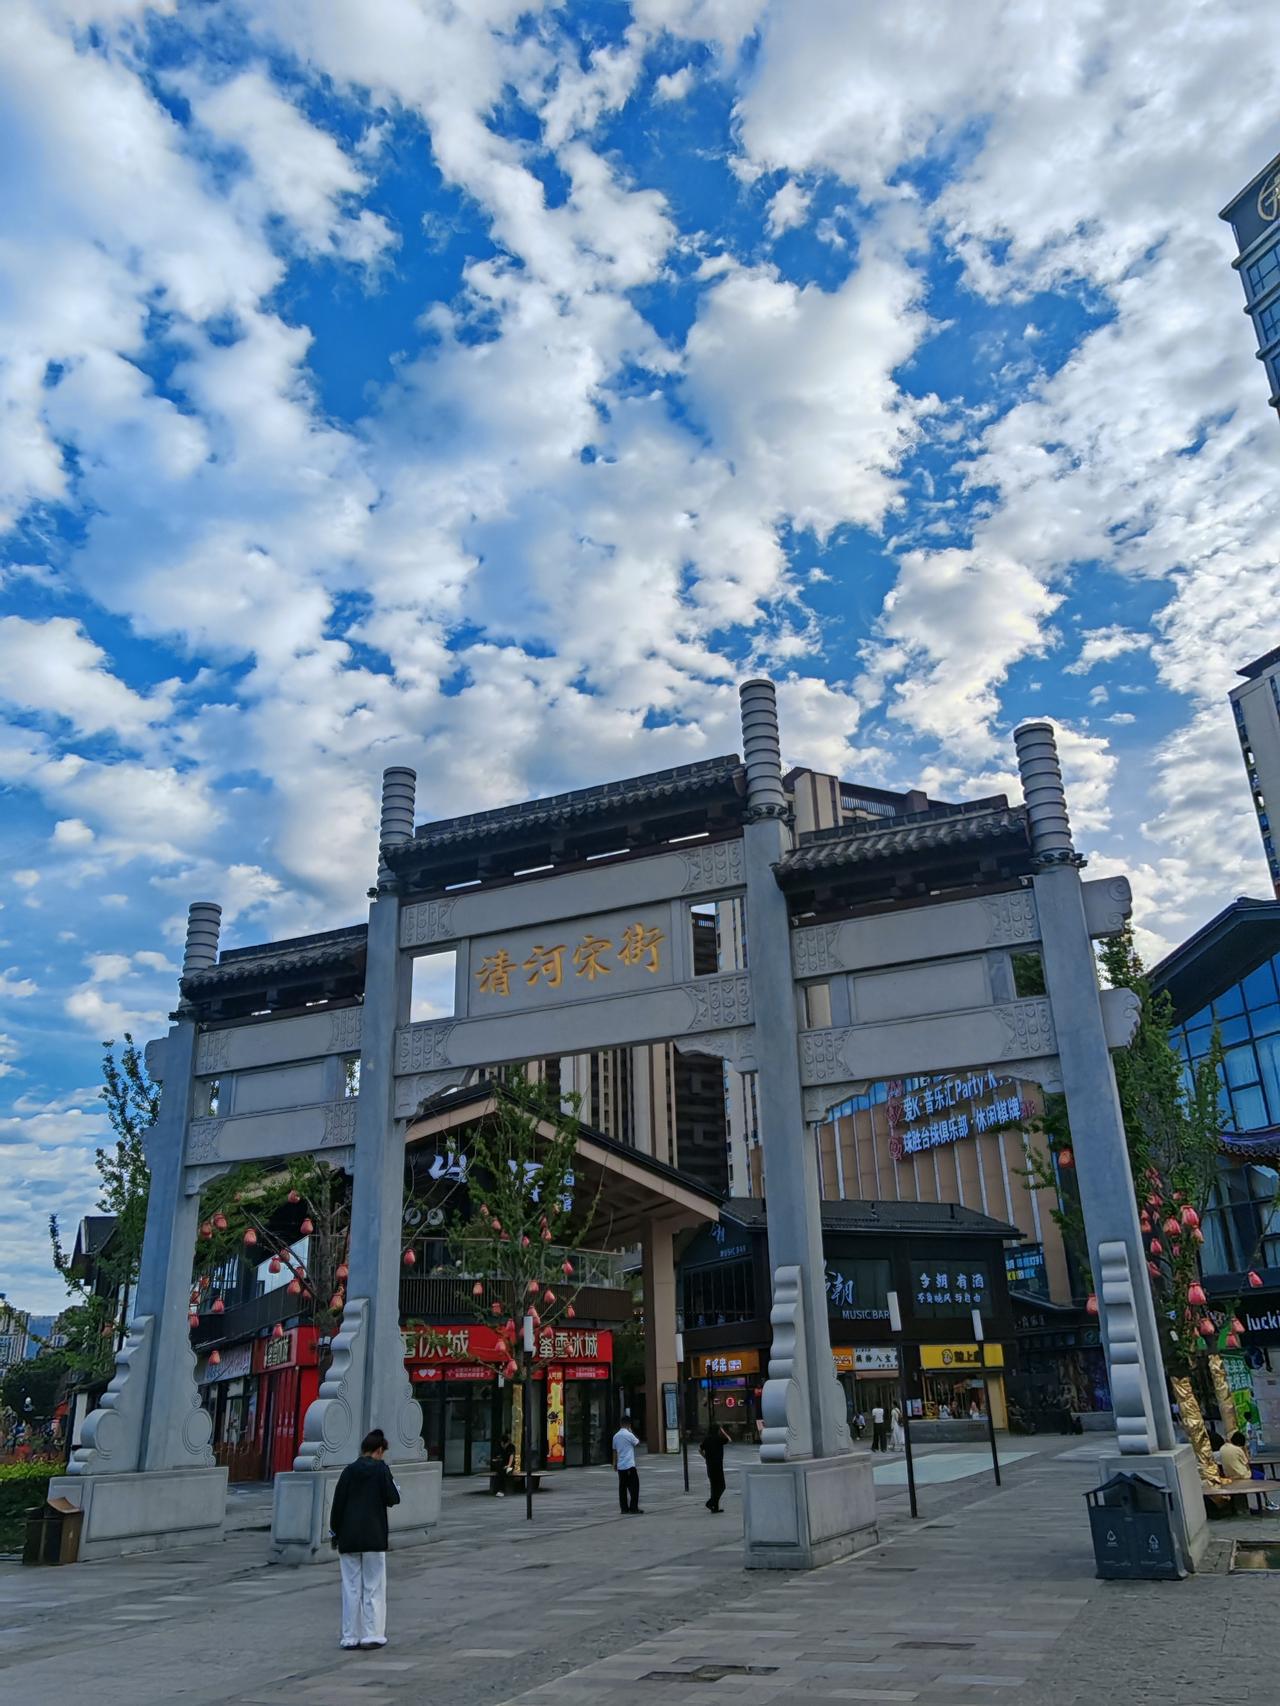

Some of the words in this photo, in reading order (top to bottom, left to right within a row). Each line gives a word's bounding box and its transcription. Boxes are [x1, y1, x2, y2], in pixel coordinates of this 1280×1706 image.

[475, 922, 665, 997] 清河宋街
[842, 1309, 872, 1321] MUSIC
[872, 1308, 890, 1320] BAR
[539, 1332, 599, 1358] 蜜雪冰城
